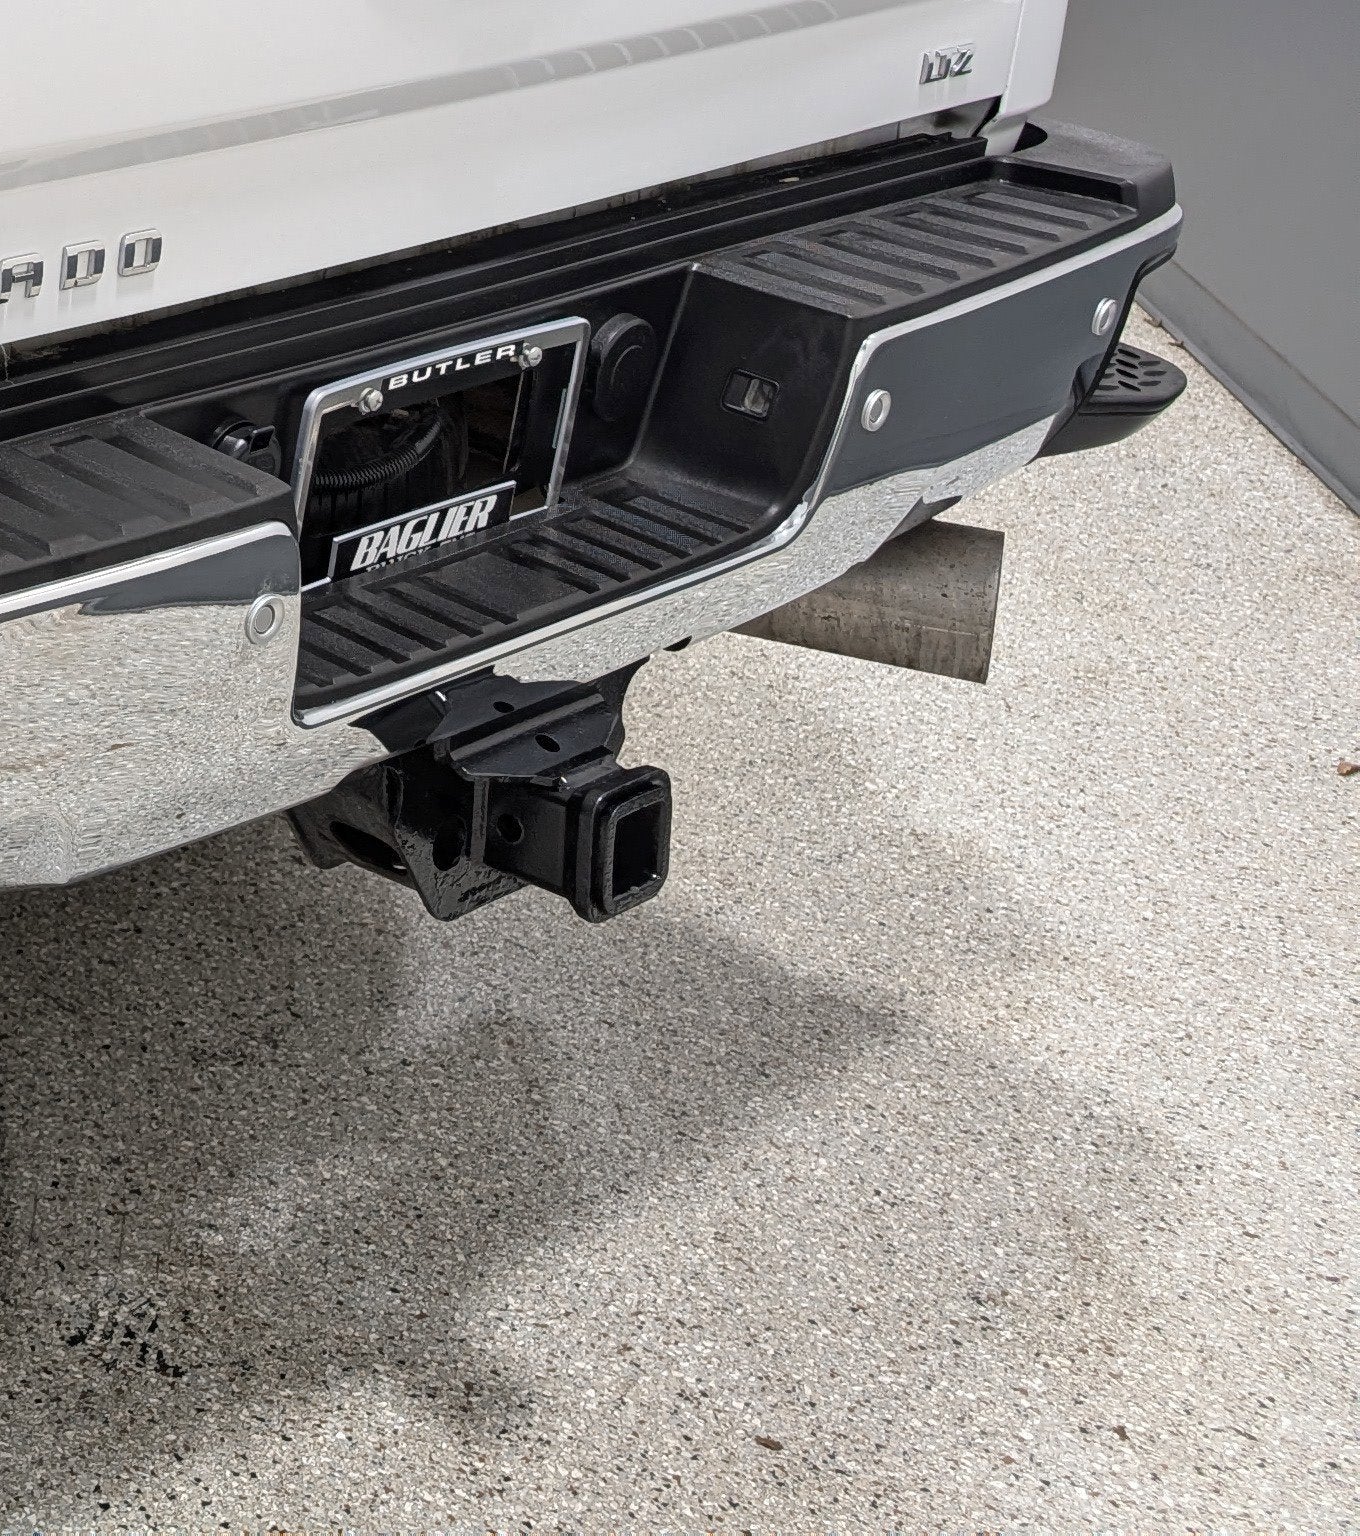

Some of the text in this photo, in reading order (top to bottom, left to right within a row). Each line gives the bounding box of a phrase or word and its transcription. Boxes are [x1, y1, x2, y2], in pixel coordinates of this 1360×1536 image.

[919, 43, 974, 84] LTZ
[388, 344, 516, 390] BUTLER
[349, 494, 498, 572] BAGLIER
